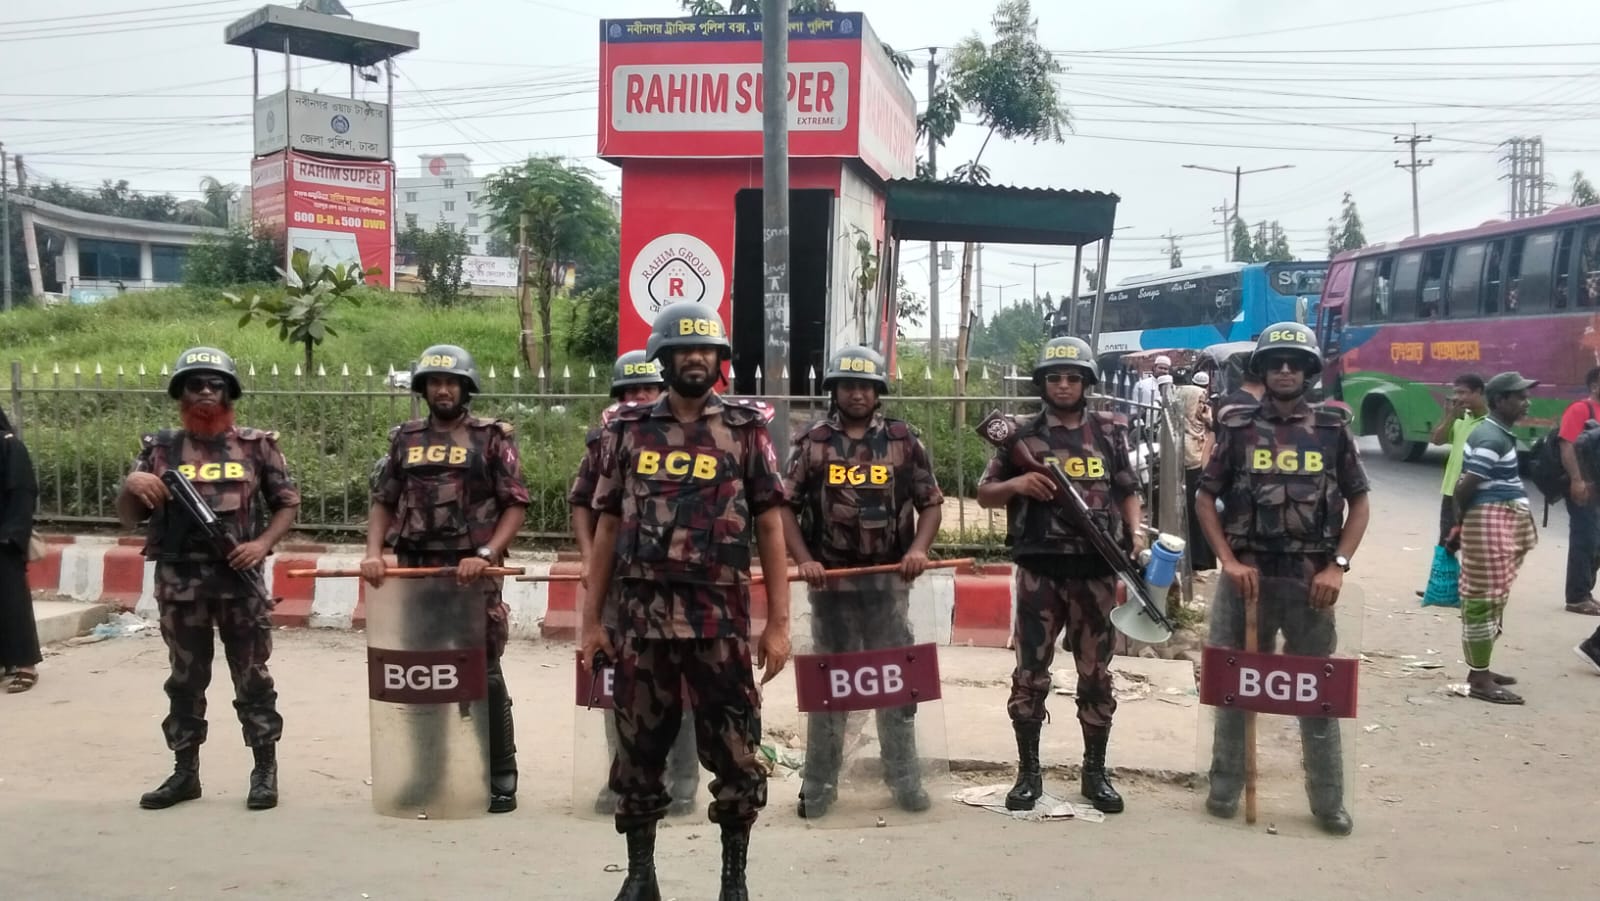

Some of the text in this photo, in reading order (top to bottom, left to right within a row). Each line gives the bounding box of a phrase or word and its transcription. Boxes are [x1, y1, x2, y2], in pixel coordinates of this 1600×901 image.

[626, 20, 663, 35] নবীনগর
[664, 19, 697, 35] ট্রাফিক
[699, 19, 726, 36] পুলিশ
[807, 17, 834, 35] পুলিশ
[626, 71, 835, 114] RAHIM SER
[797, 117, 835, 126] EXTREME
[300, 134, 324, 146] জেলা
[358, 141, 378, 152] ঢাকা
[300, 162, 340, 180] RAHIM
[342, 168, 380, 185] SUPER
[341, 215, 361, 227] 500
[641, 247, 712, 280] RAHIM GROUP
[669, 277, 685, 297] R
[1137, 288, 1160, 304] Sonya
[680, 319, 720, 337] BGB
[1269, 330, 1307, 344] BGB
[186, 352, 222, 365] BGB
[421, 355, 454, 368] BGB
[1045, 346, 1079, 359] BGB
[624, 363, 656, 376] BGB
[840, 358, 876, 373] BGB
[408, 445, 467, 465] BGB
[1253, 449, 1324, 472] BGB
[178, 462, 244, 480] BGB
[829, 464, 888, 486] BGB
[384, 664, 459, 690] BGB
[830, 664, 904, 699] BGB
[1239, 667, 1319, 702] BGB
